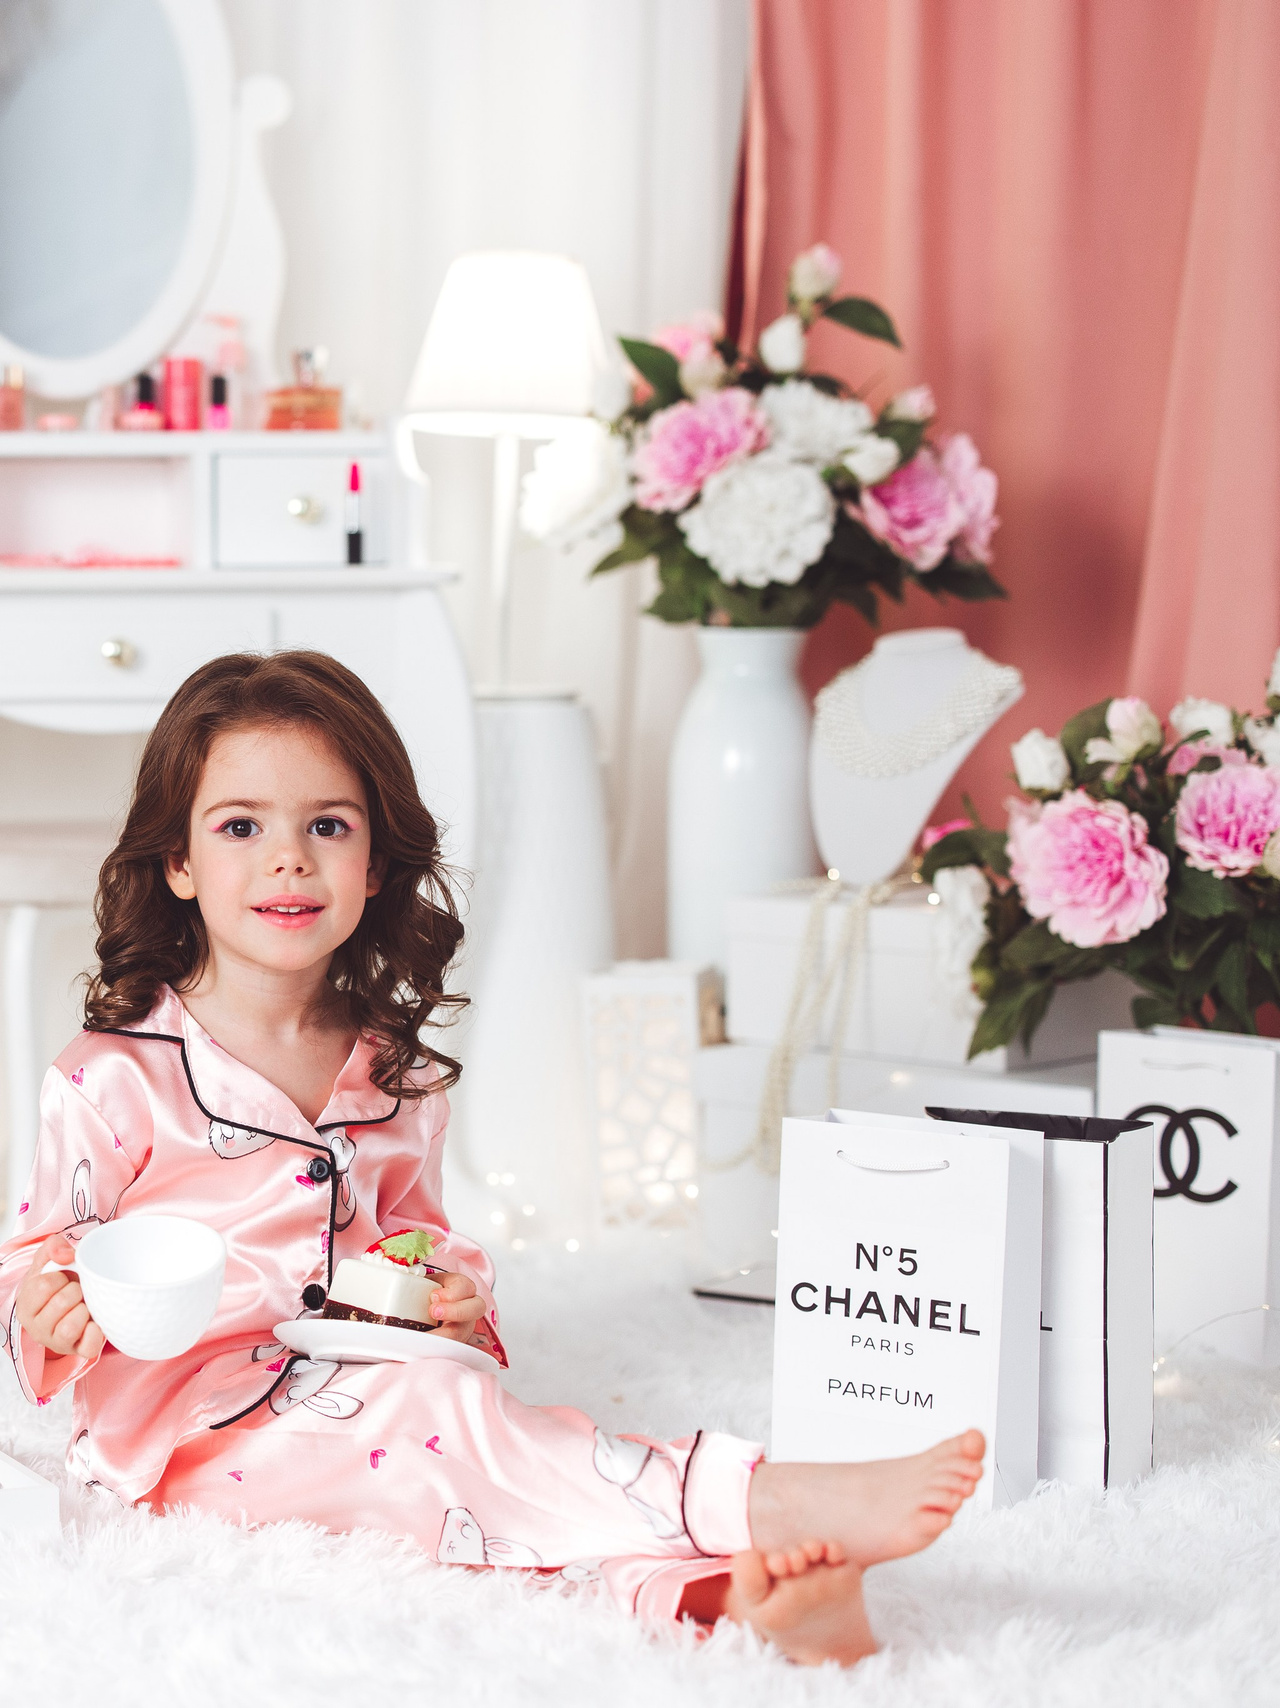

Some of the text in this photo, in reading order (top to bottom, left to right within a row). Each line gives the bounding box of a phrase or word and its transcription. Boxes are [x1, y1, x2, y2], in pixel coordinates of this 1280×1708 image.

[790, 1281, 981, 1337] CHANEL
[851, 1334, 915, 1356] PARIS
[827, 1378, 934, 1410] PARFUM
